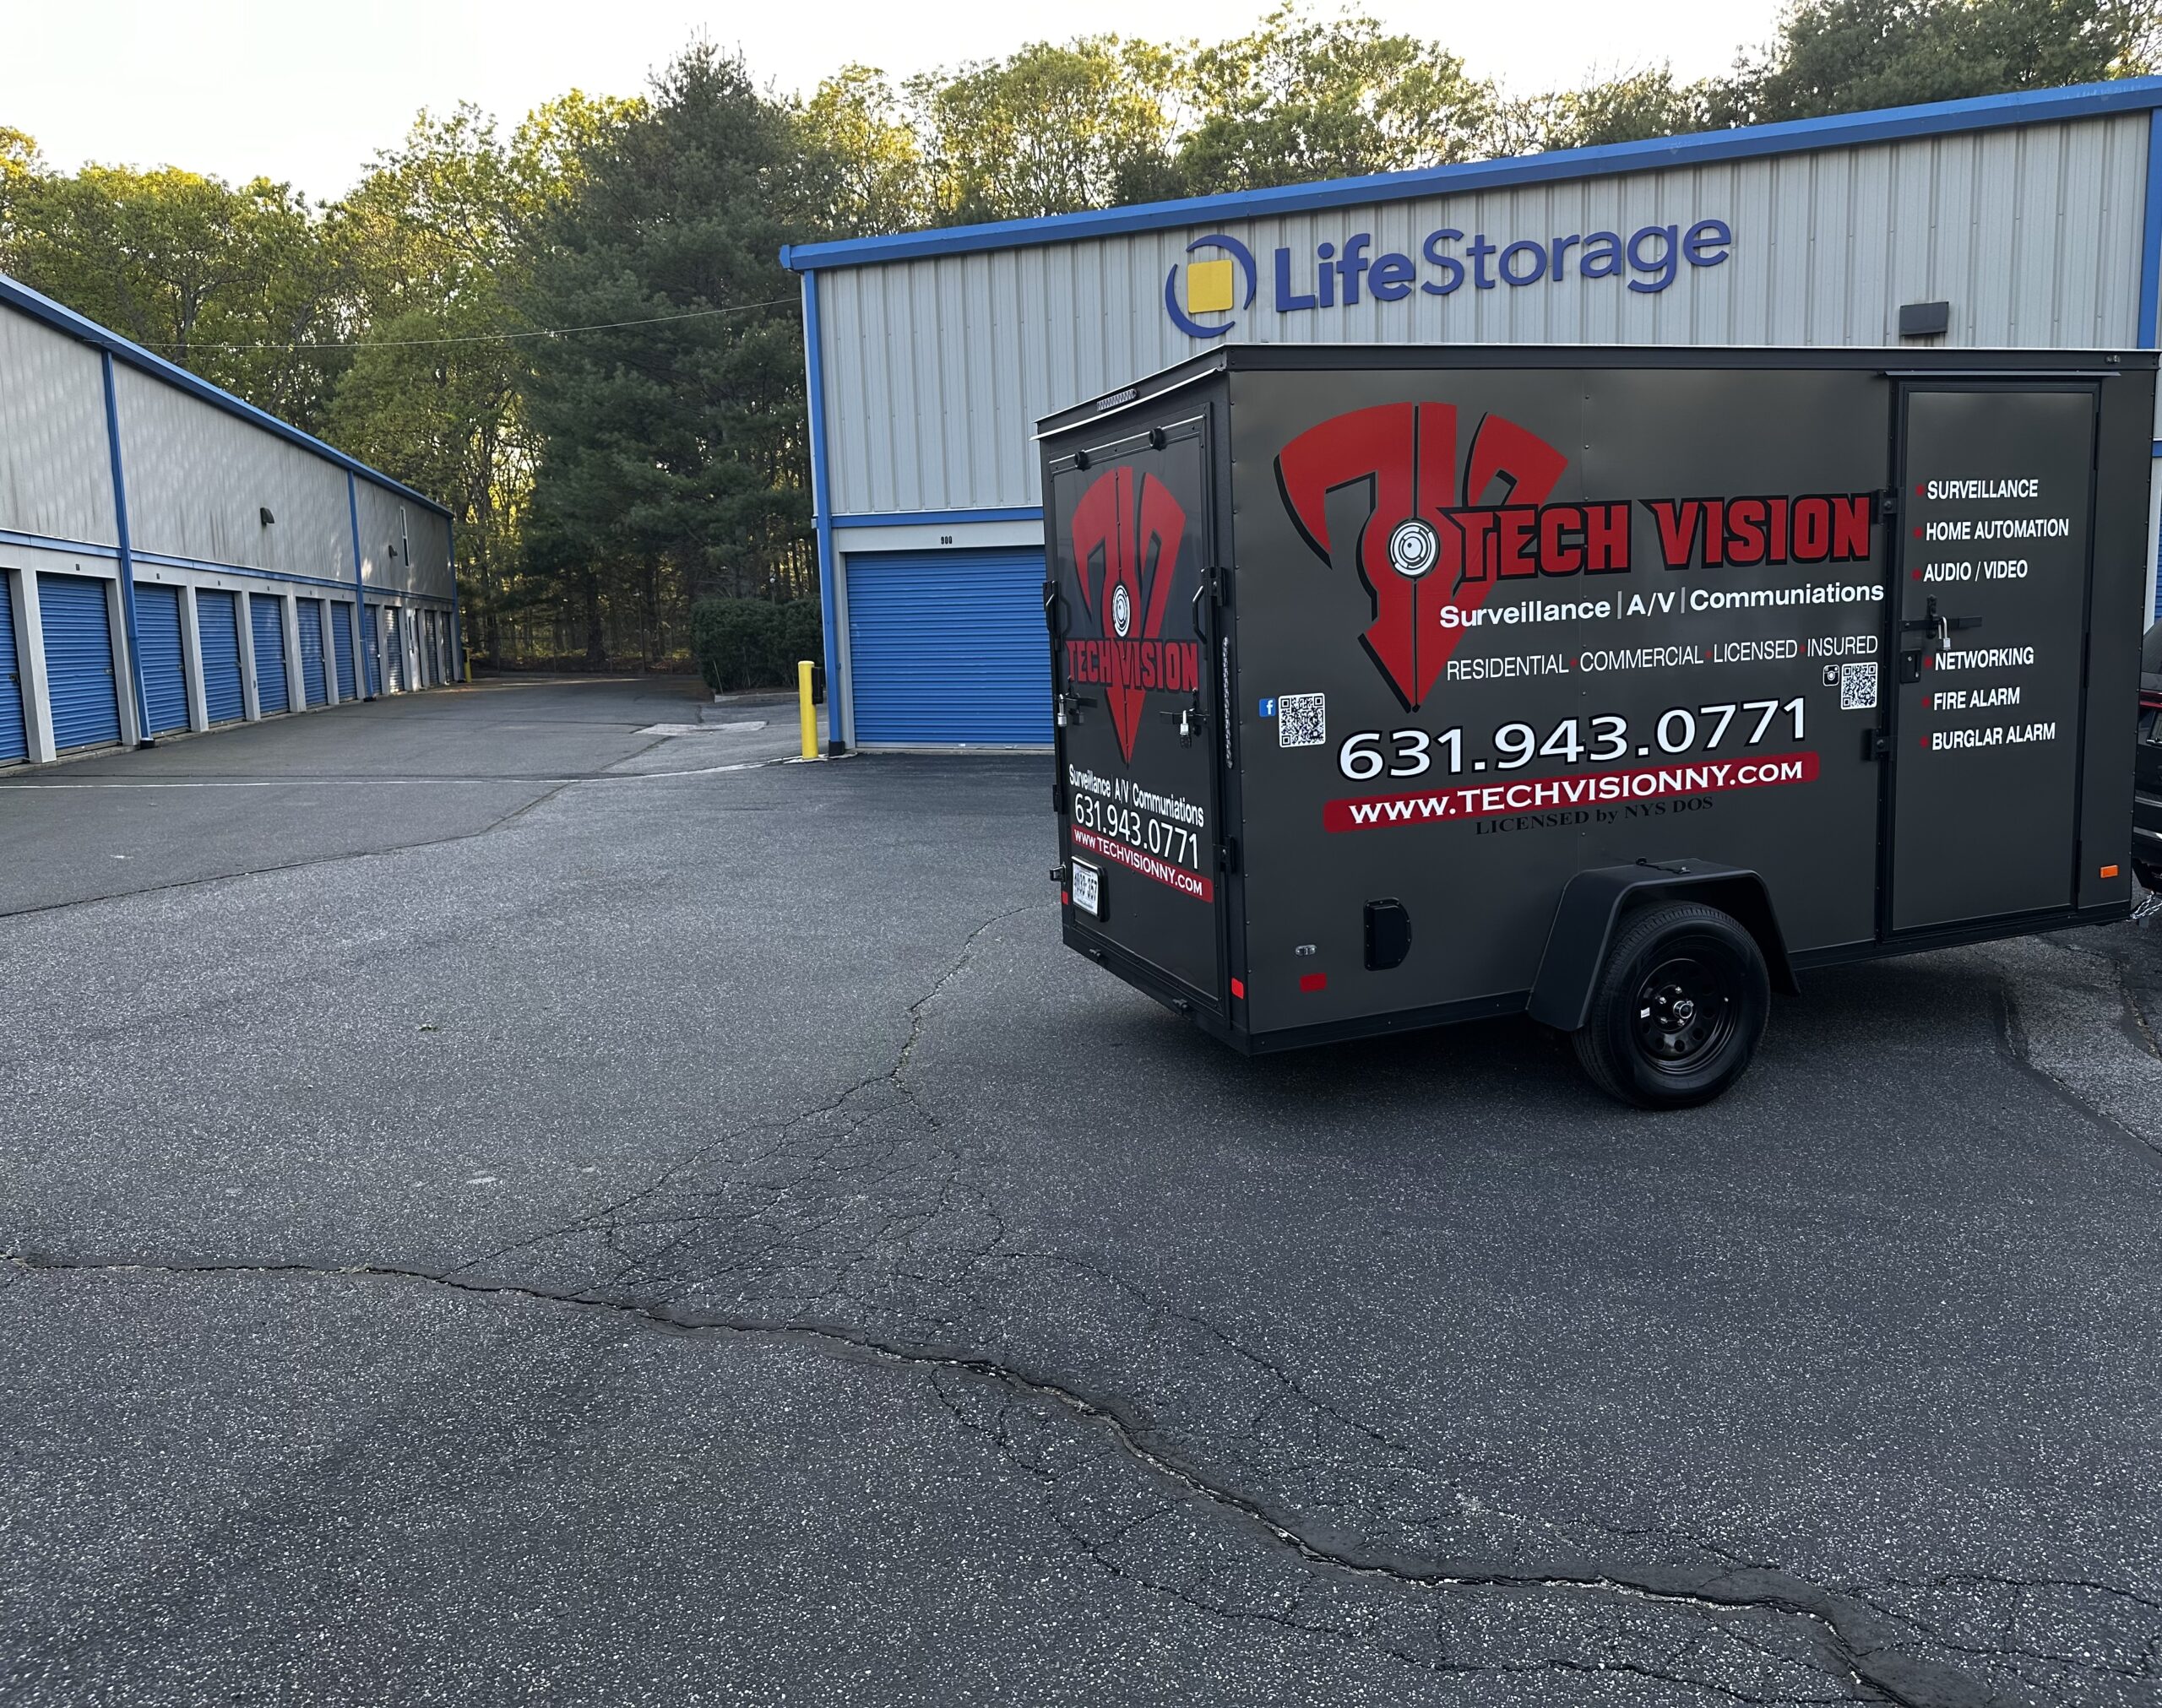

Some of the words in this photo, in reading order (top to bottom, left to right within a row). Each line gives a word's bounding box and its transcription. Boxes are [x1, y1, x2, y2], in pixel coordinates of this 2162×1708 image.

[1927, 479, 2039, 500] SURVEILLANCE
[1436, 501, 1632, 581] TECH
[1637, 493, 1871, 570] VISION
[1926, 521, 1971, 541] HOME
[1974, 518, 2069, 540] AUTOMATION
[1923, 561, 1972, 582] AUDIO
[1984, 559, 2029, 579] VIDEO
[1439, 600, 1611, 628] Surveillance
[1627, 591, 1676, 617] A/V
[1690, 582, 1884, 611] Communiations
[1447, 653, 1569, 681] RESIDENTIAL
[1579, 645, 1704, 672] COMMERCIAL
[1714, 639, 1798, 663] LICENSED
[1807, 635, 1878, 658] INSURED
[1935, 646, 2034, 671] NETWORKING
[1933, 691, 1967, 711] FIRE
[1969, 686, 2021, 708] ALARM
[1339, 697, 1806, 781] 631.943.0771
[1931, 727, 2003, 751] BURGLAR
[2006, 722, 2056, 744] ALARM
[1069, 763, 1111, 797] Surveillance
[1115, 778, 1129, 804] A/V
[1133, 783, 1204, 827] Communiations
[1476, 810, 1589, 835] LICENSED
[1596, 809, 1618, 824] by
[1624, 800, 1666, 818] NYS
[1673, 795, 1714, 813] DOS
[1074, 793, 1198, 870] 631.943.0771
